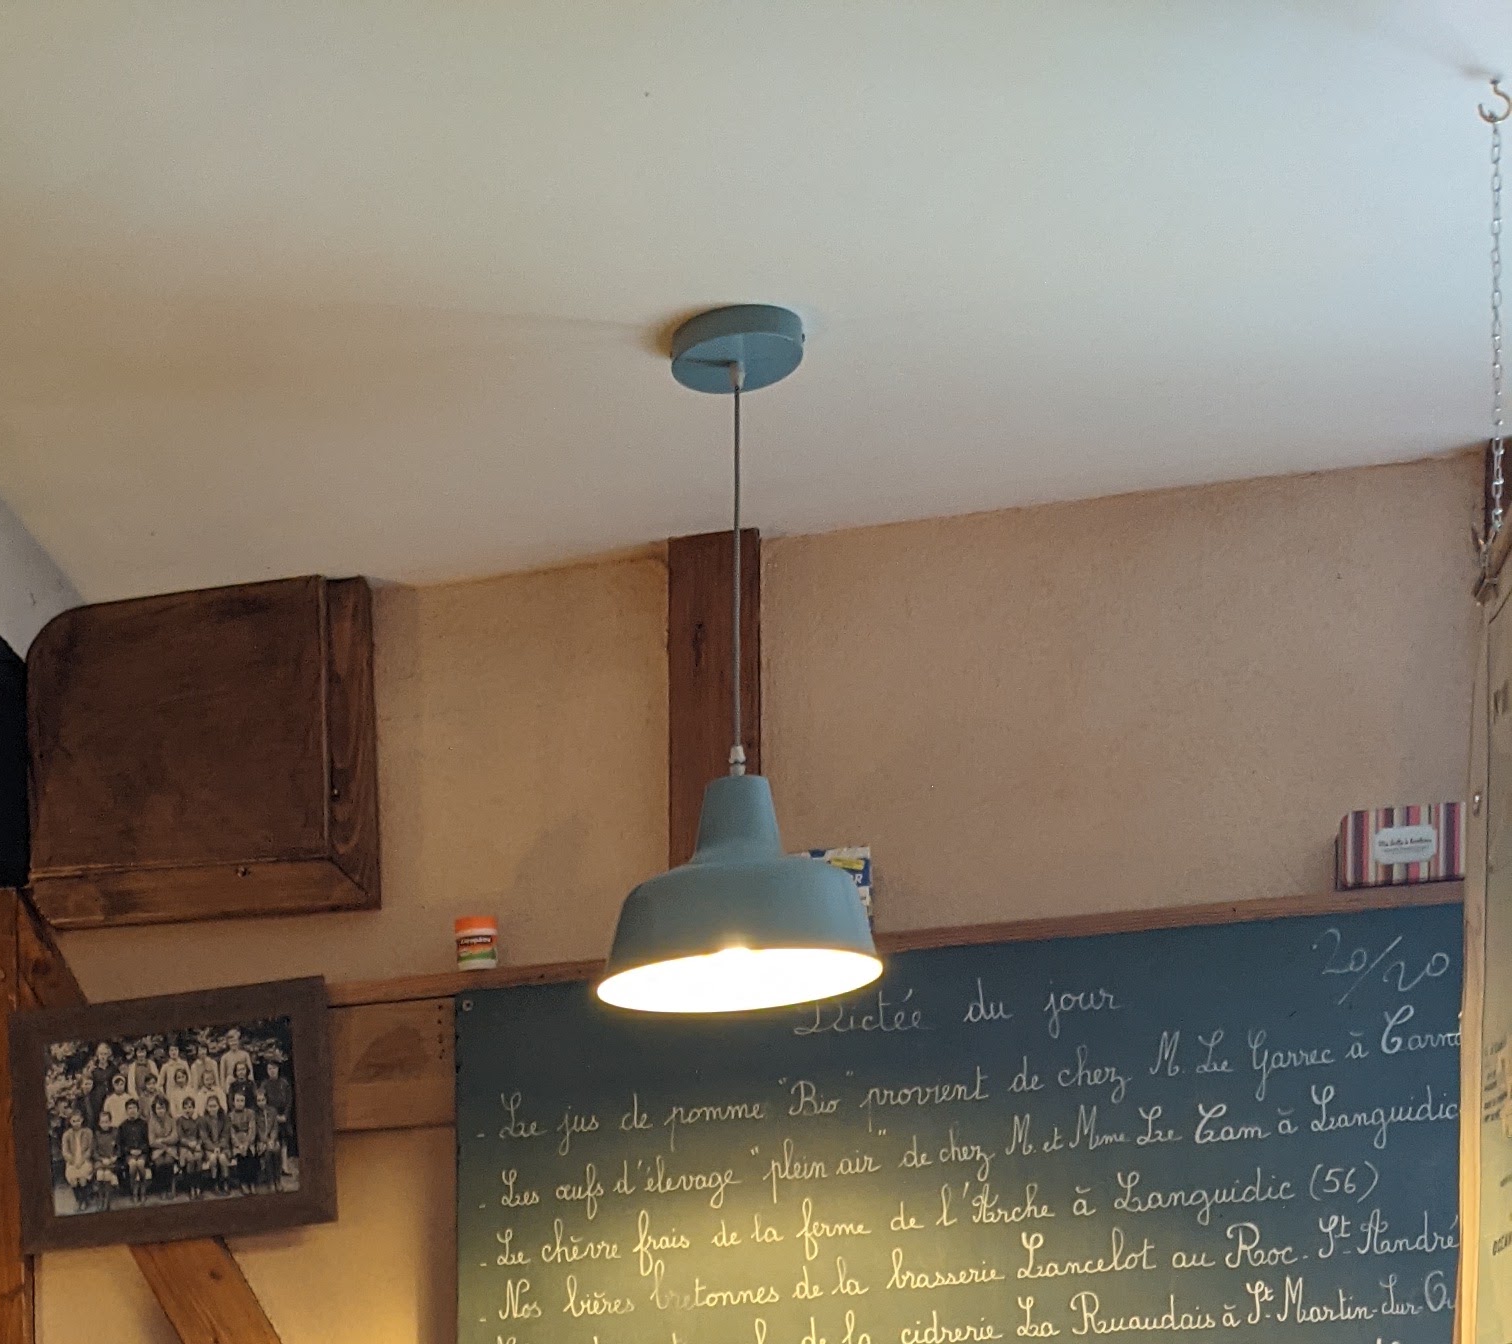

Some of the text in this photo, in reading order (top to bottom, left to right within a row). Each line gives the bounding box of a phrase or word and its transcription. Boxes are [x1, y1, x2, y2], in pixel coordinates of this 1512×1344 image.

[794, 978, 1121, 1037] Dictée du jour
[1311, 928, 1449, 1005] 20/20
[499, 1093, 546, 1139] Le
[557, 1106, 599, 1156] jus
[620, 1094, 653, 1131] de
[665, 1102, 767, 1152] pomme
[860, 1066, 988, 1133] provient
[1009, 1056, 1045, 1092] de
[1058, 1045, 1132, 1104] chez
[1150, 1030, 1185, 1077] M.
[1197, 1028, 1234, 1073] Le
[1346, 1032, 1369, 1059] à
[501, 1169, 539, 1208] Les
[613, 1155, 742, 1210] d'élevage
[899, 1135, 932, 1169] de
[940, 1121, 995, 1181] chez
[1043, 1124, 1063, 1152] et
[1069, 1104, 1125, 1152] Mme
[1137, 1105, 1182, 1145] Le
[1278, 1107, 1299, 1135] à
[1311, 1085, 1458, 1149] Languidic
[497, 1229, 531, 1266] Le
[542, 1219, 622, 1263] chèvre
[632, 1210, 690, 1276] frais
[710, 1219, 742, 1248] de
[750, 1214, 784, 1243] la
[796, 1198, 871, 1260] ferme
[890, 1201, 924, 1231] de
[1073, 1186, 1096, 1217] à
[1114, 1167, 1295, 1226] Languidic
[1309, 1160, 1379, 1203] (56)
[499, 1278, 541, 1320] Nos
[563, 1275, 635, 1318] bières
[793, 1265, 823, 1299] de
[832, 1256, 870, 1296] la
[886, 1248, 1004, 1289] brasserie
[1017, 1226, 1157, 1279] Lancelot
[1172, 1250, 1216, 1270] au
[1016, 1297, 1061, 1338] La
[1070, 1291, 1216, 1335] Ruaudais
[1222, 1304, 1240, 1329] à
